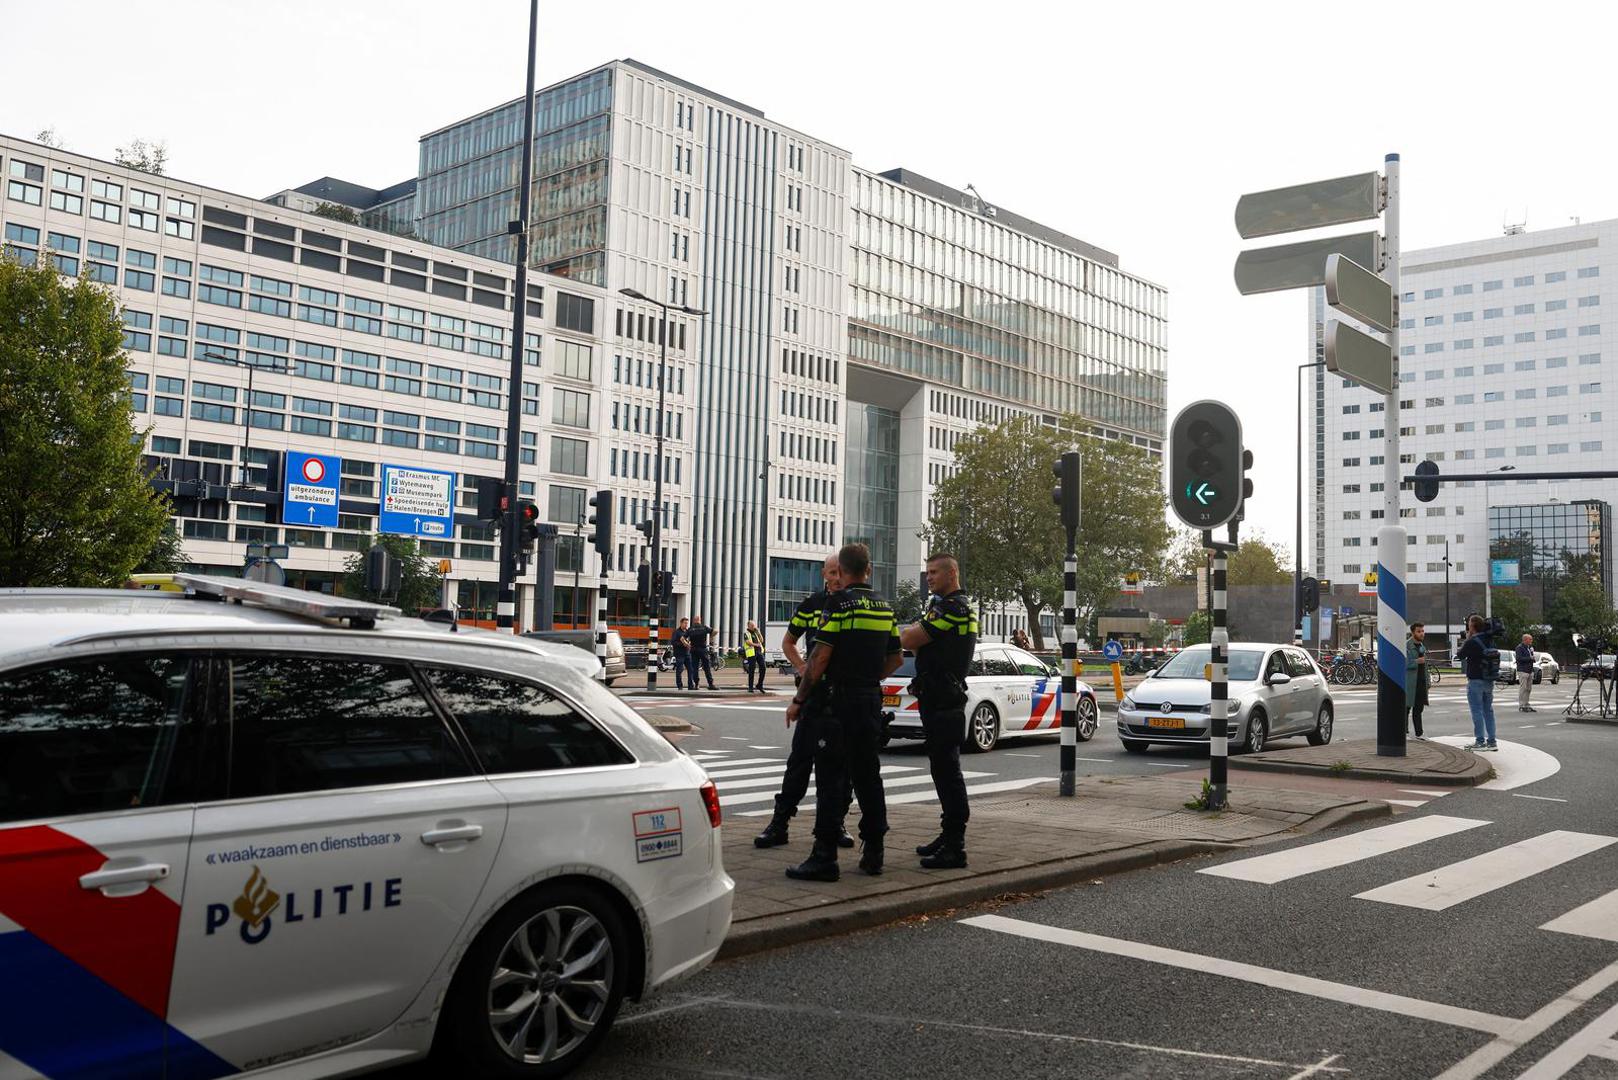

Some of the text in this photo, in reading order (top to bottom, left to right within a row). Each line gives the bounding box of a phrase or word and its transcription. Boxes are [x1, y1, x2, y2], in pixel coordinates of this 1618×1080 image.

[406, 471, 430, 480] Erasmus
[290, 486, 335, 496] uitgezonderd
[406, 489, 442, 499] Museumpark
[295, 494, 331, 503] ambulance
[395, 497, 434, 507] Spoedeisende
[1007, 692, 1030, 704] POLITIE
[651, 814, 665, 827] 112
[218, 844, 299, 864] waakzaam
[300, 841, 318, 855] en
[320, 832, 390, 852] dienstbaar
[205, 877, 403, 945] POLITIE
